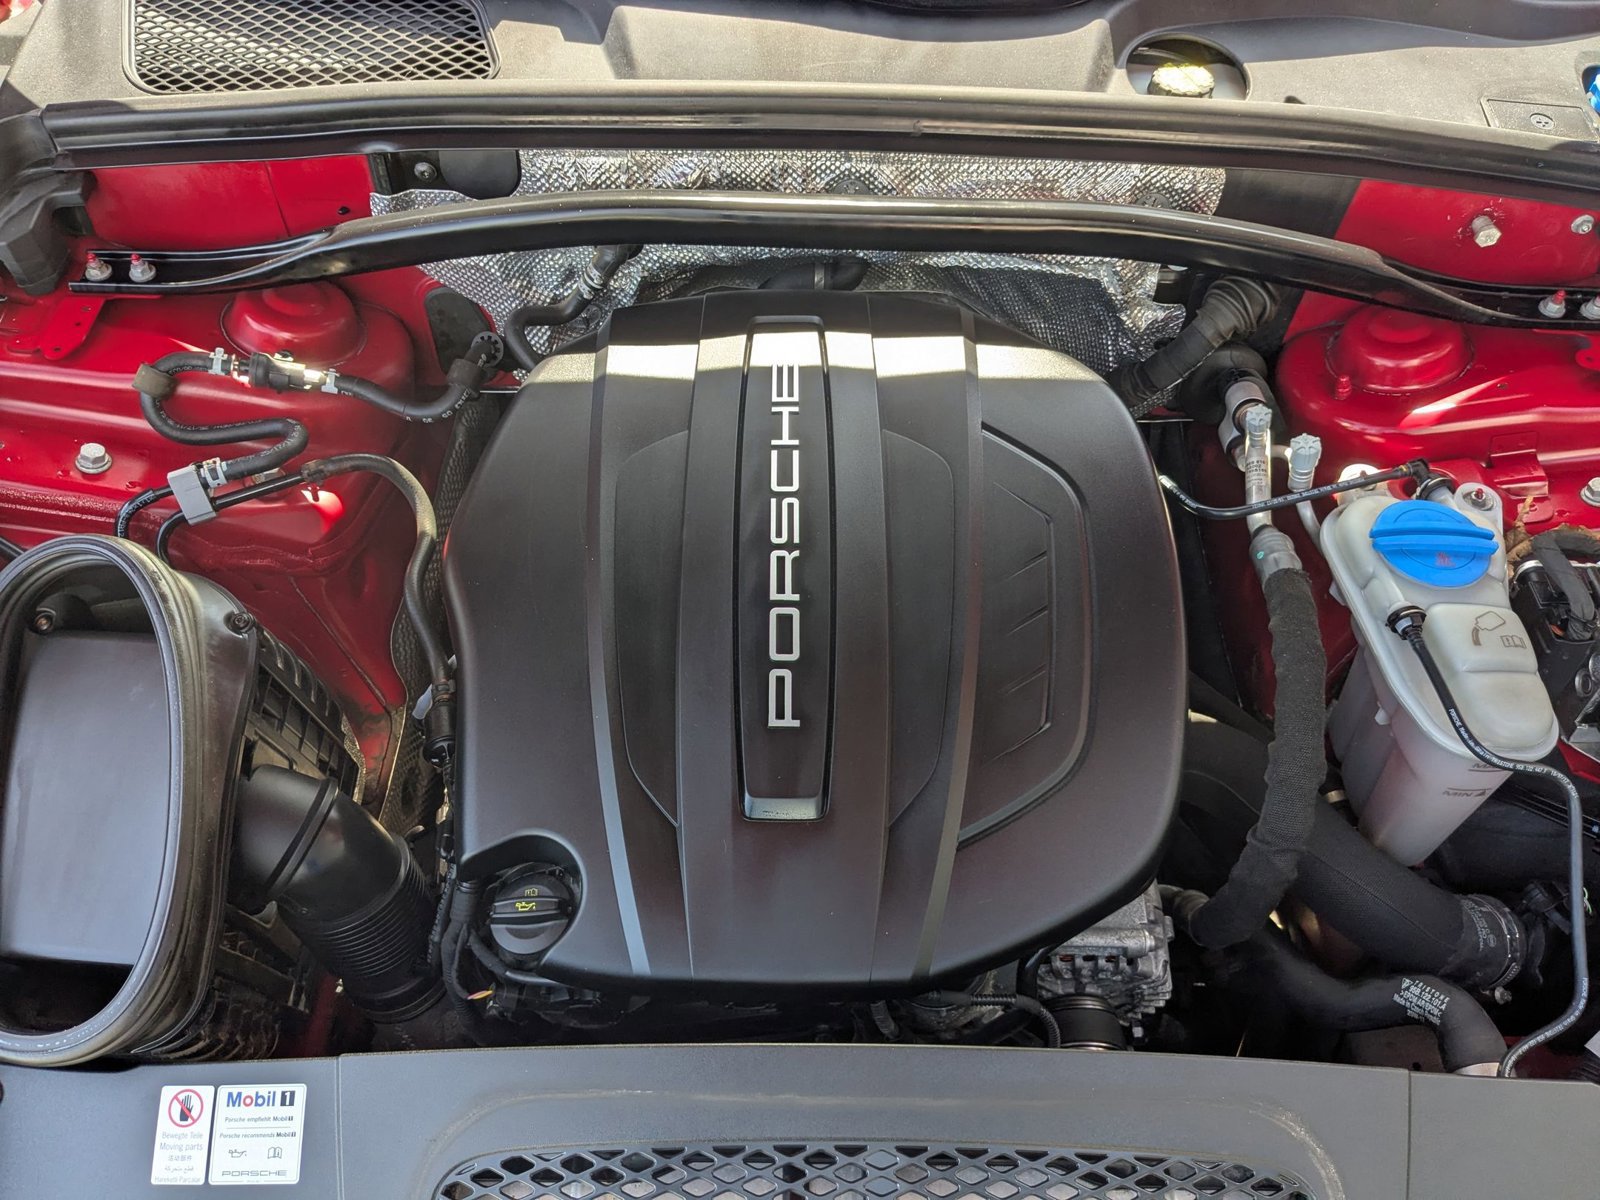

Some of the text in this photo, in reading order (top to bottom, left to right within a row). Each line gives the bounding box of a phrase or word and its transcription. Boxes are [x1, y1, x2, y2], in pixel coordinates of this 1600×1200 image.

[768, 363, 800, 728] PORSCHE
[1414, 980, 1450, 1004] TRISTONE
[226, 1090, 277, 1107] Mobil
[160, 1142, 204, 1152] Moving parts
